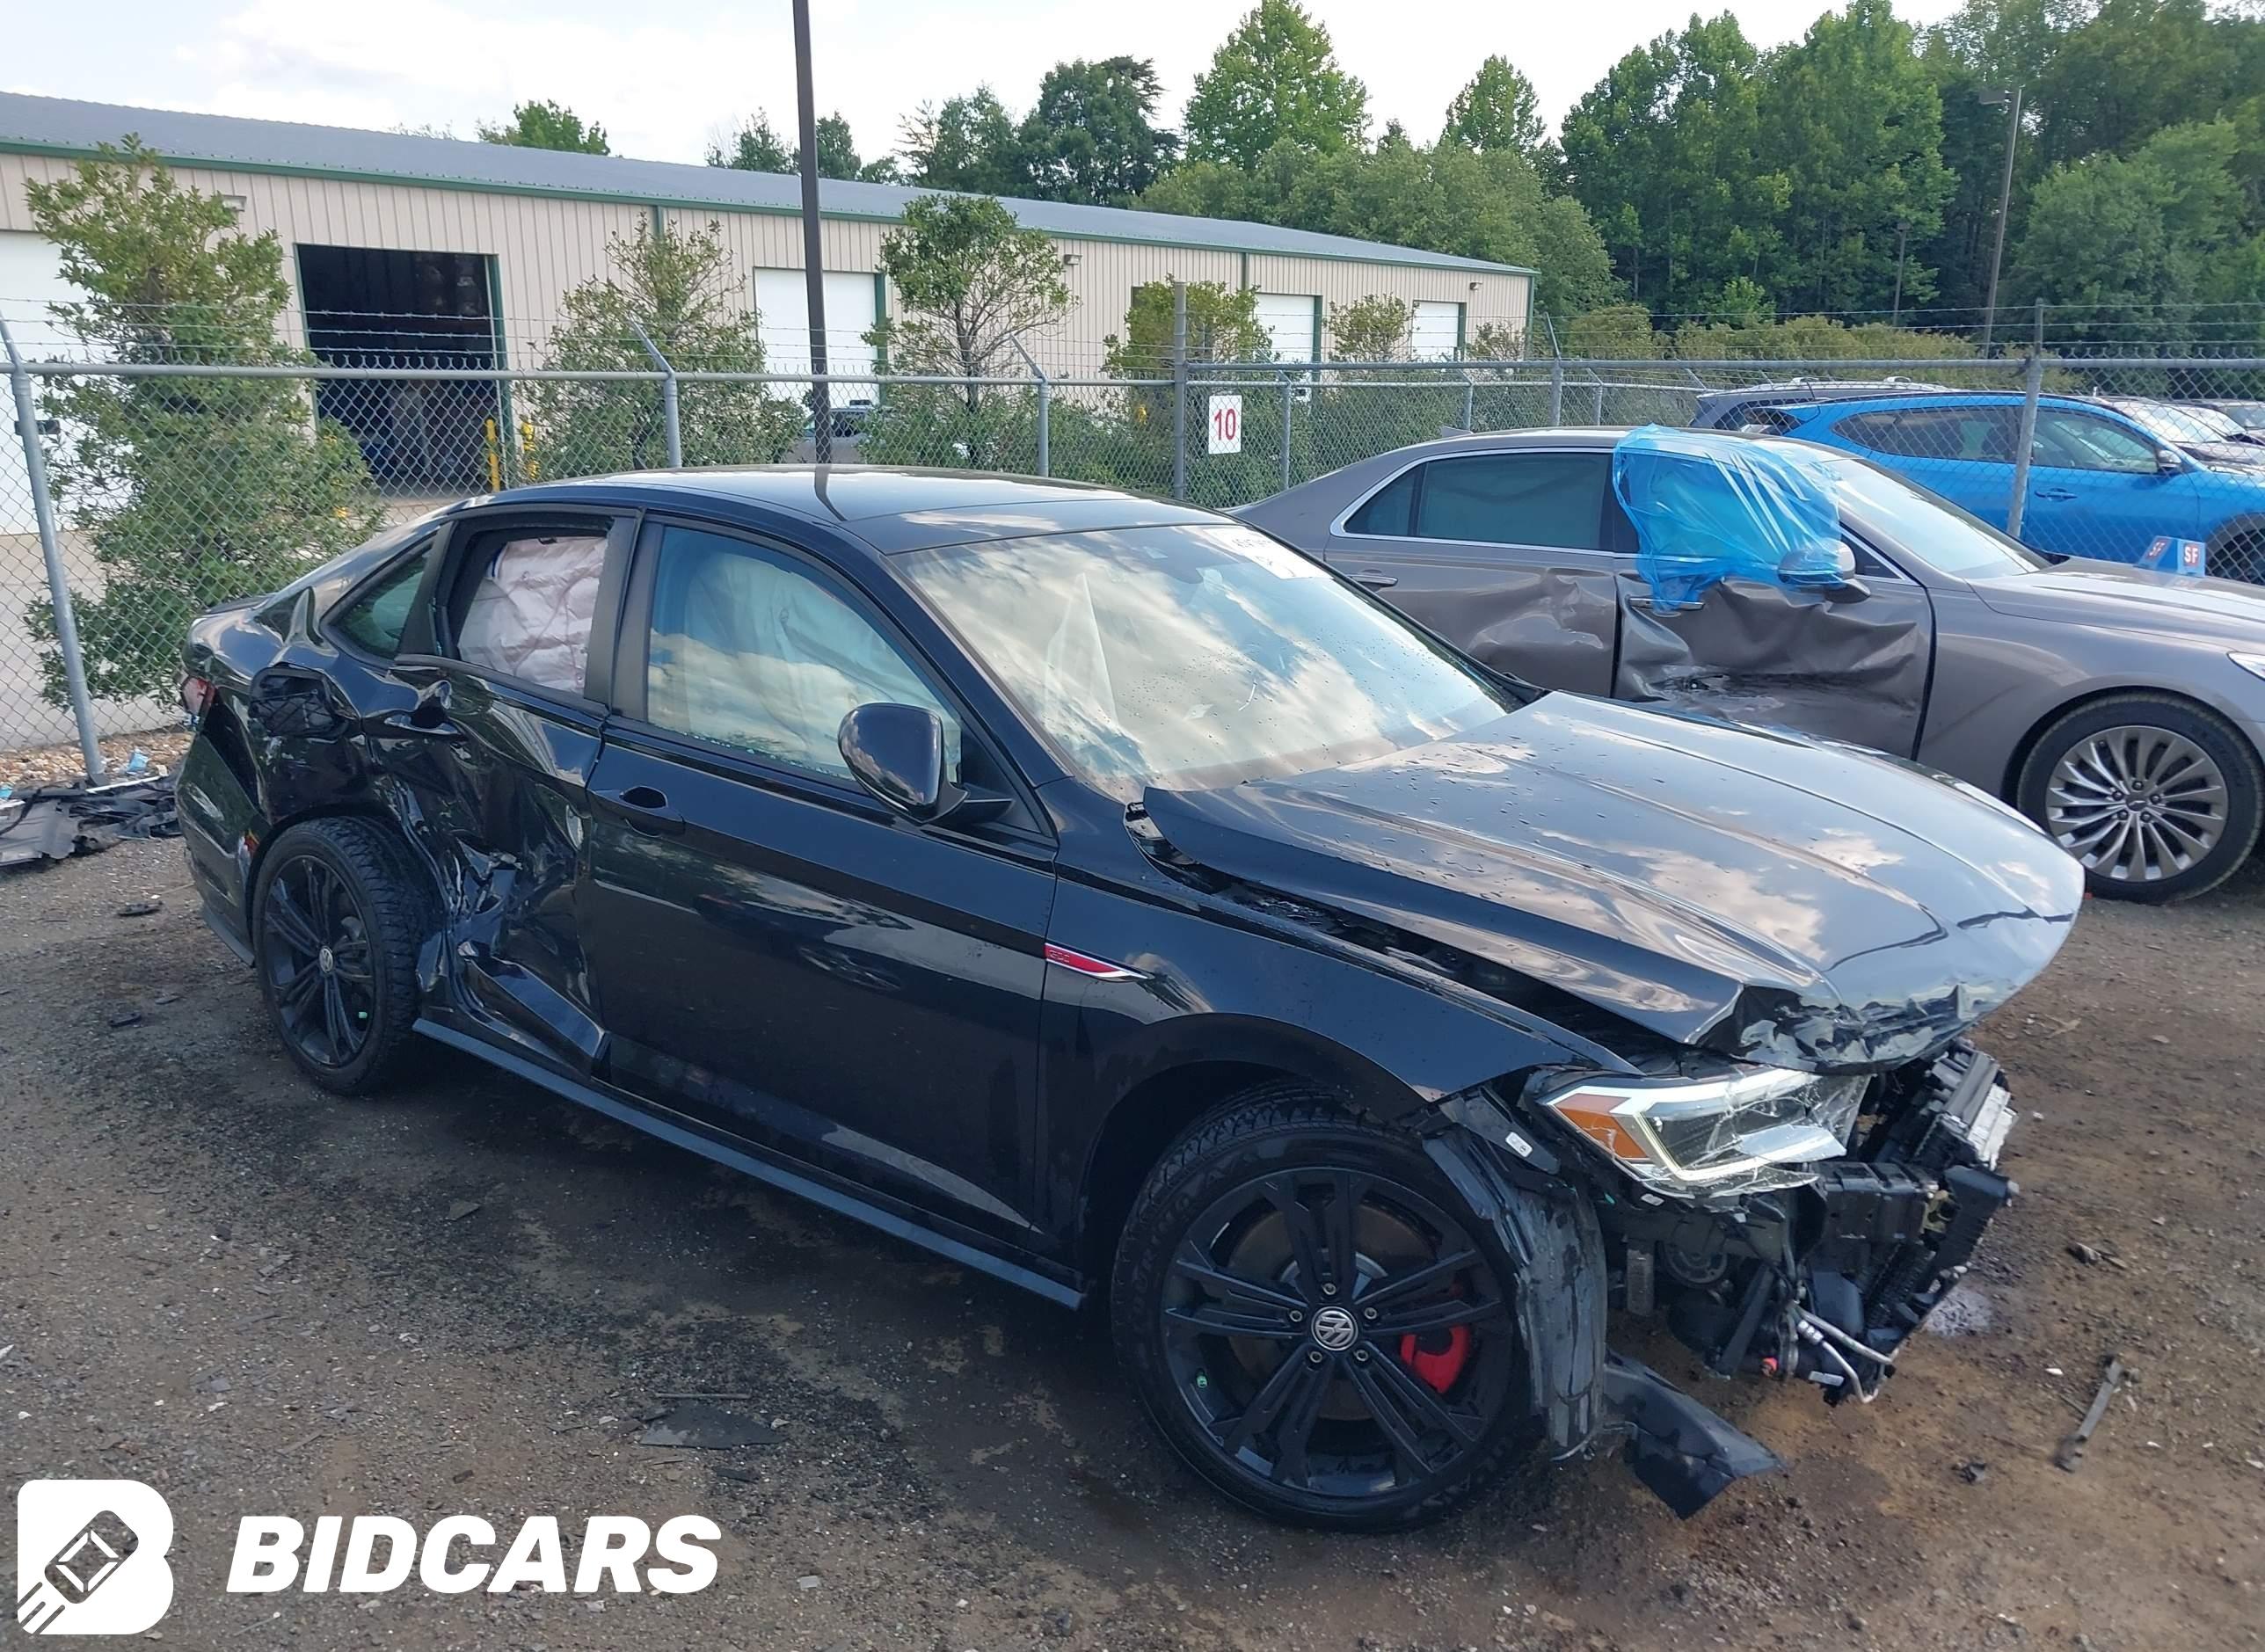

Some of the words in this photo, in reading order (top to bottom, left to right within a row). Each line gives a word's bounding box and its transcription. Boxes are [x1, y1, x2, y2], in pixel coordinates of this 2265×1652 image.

[1214, 408, 1236, 440] 10
[2184, 546, 2199, 564] SF
[1313, 1307, 1357, 1350] VW
